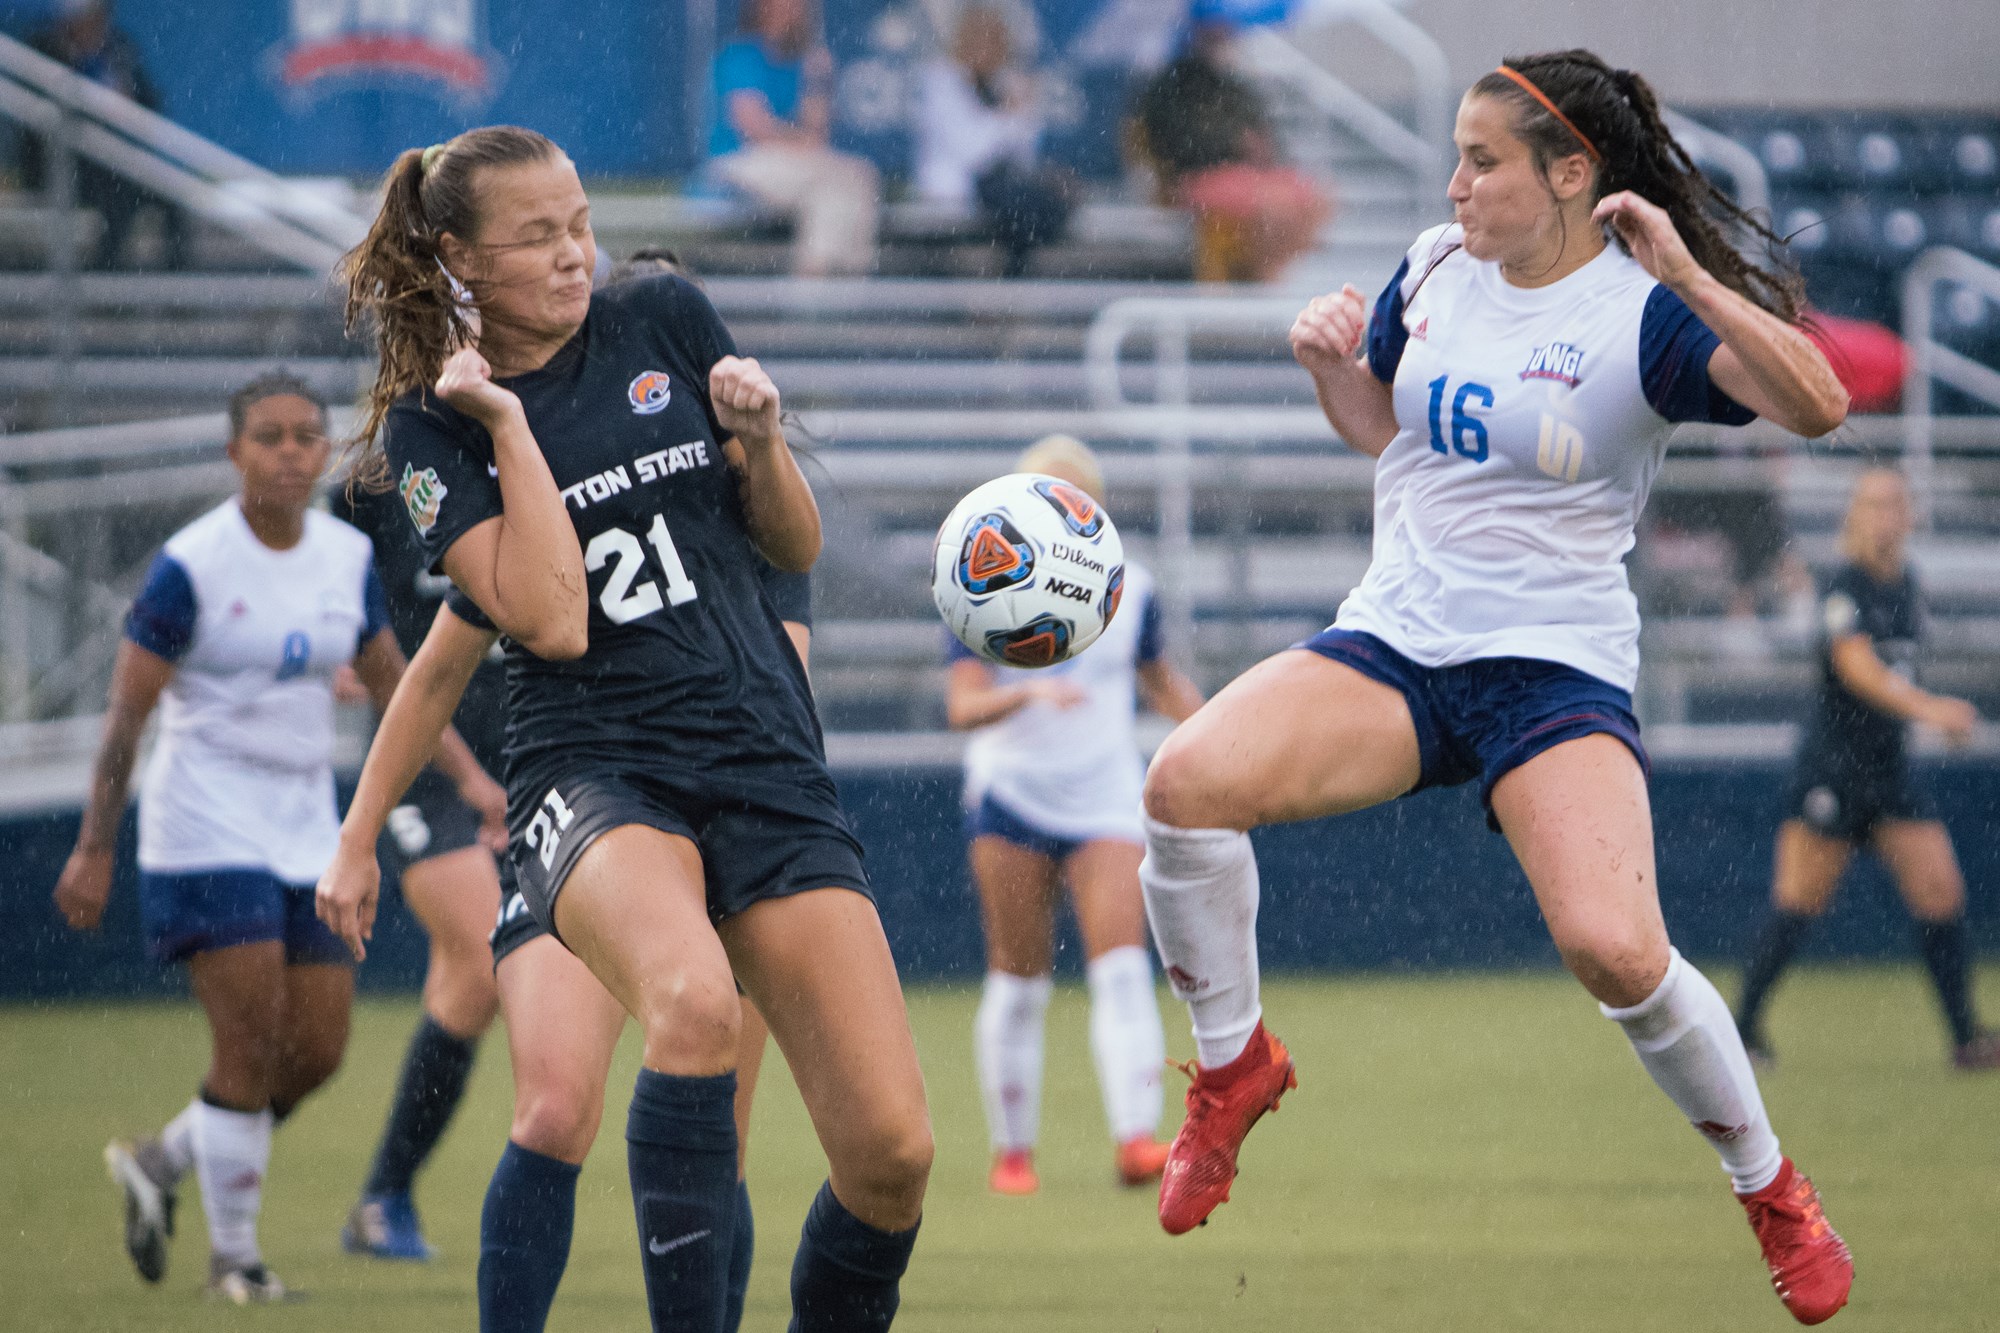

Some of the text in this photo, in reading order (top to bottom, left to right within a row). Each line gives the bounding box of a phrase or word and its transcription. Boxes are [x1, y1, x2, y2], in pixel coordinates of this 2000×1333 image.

[1525, 342, 1583, 377] UWG
[1428, 373, 1495, 464] 16
[560, 440, 710, 510] TON STATE
[584, 513, 697, 625] 21
[1044, 576, 1093, 604] NCAA
[1052, 542, 1104, 575] Wilson
[526, 787, 575, 872] 21
